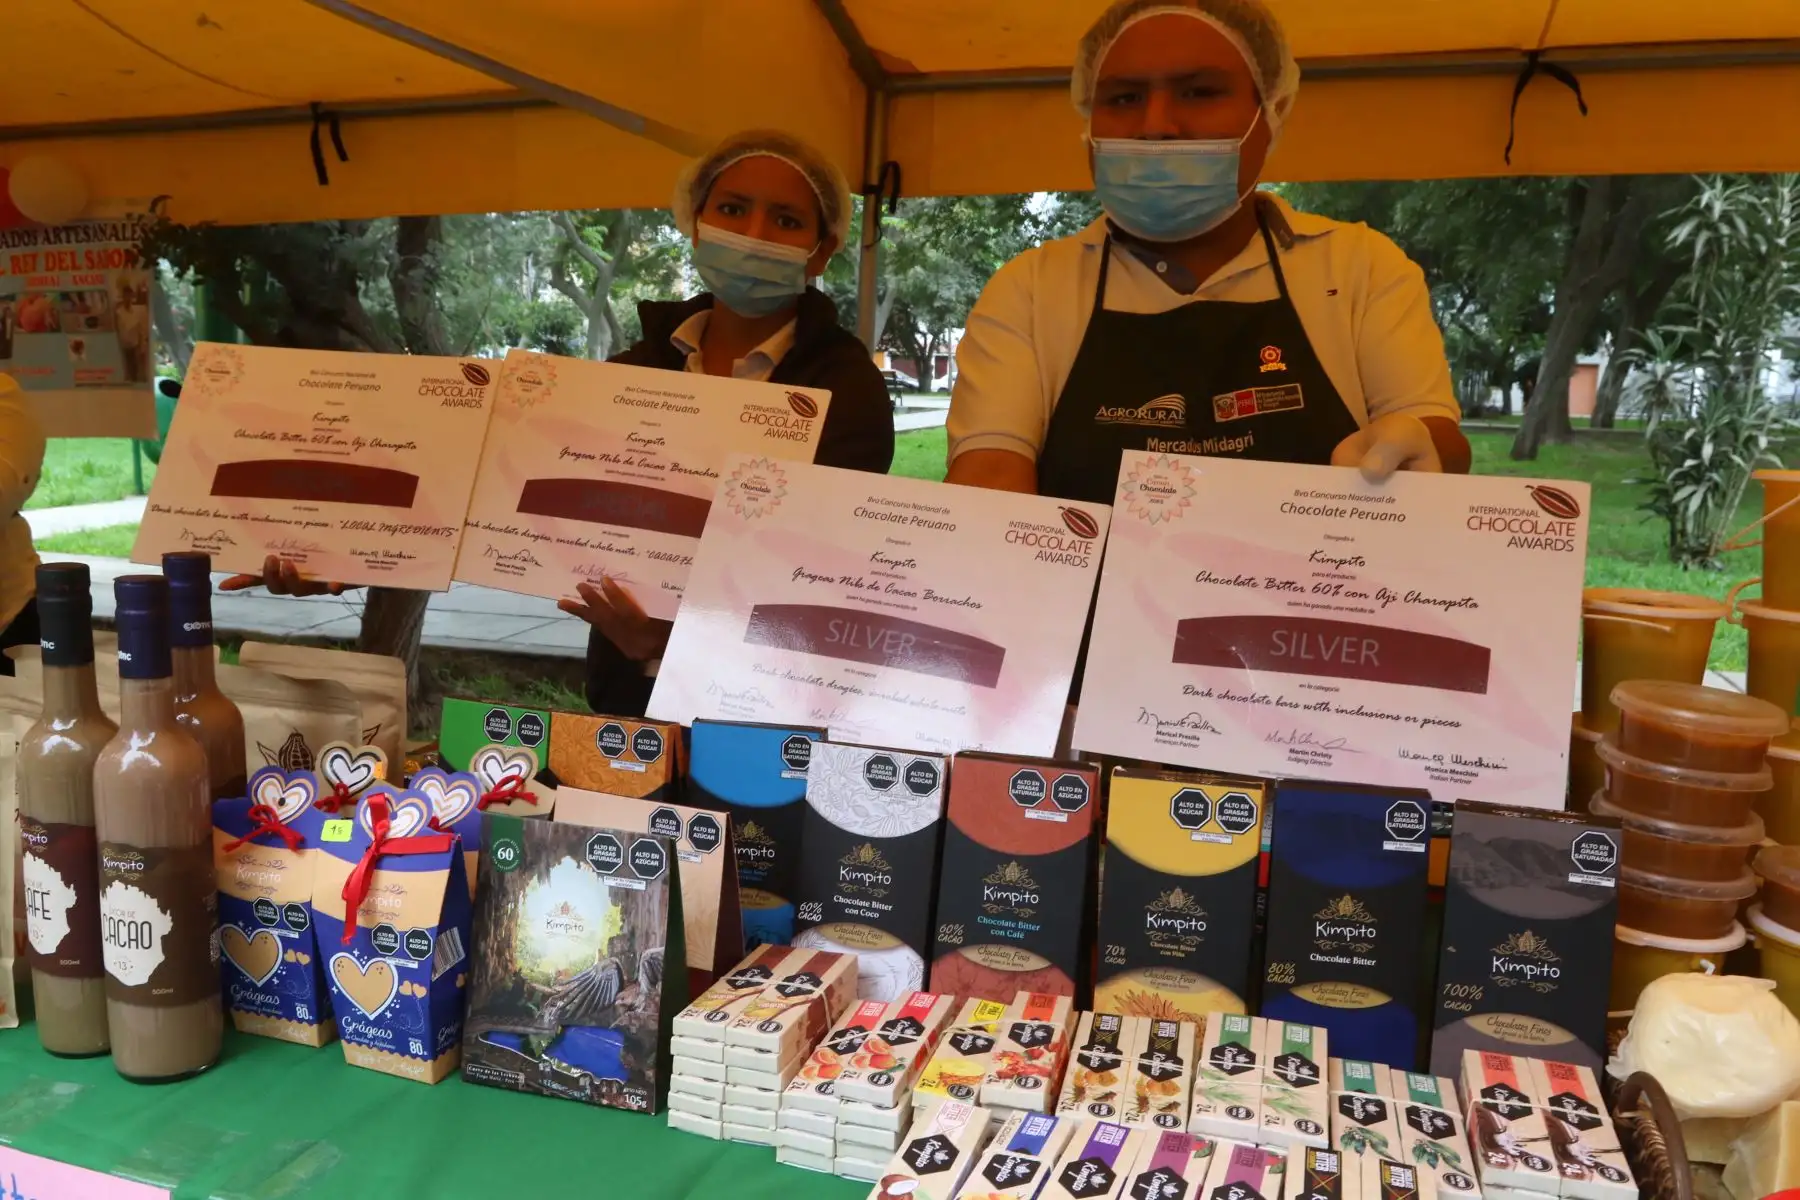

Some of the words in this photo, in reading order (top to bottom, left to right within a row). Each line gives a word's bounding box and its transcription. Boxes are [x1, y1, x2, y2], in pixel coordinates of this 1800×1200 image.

[44, 250, 83, 271] DEL
[299, 378, 343, 390] Chocolate
[344, 382, 381, 392] Peruano
[418, 385, 485, 399] CHOCOLATE
[441, 398, 482, 409] AWARDS
[613, 394, 660, 410] Chocolate
[661, 401, 700, 416] Peruano
[743, 403, 791, 417] INTERNATIONAL
[1096, 405, 1186, 421] AGRORURAL
[740, 411, 813, 433] CHOCOLATE
[625, 431, 666, 448] Kimpito
[764, 427, 809, 443] AWARDS
[1147, 437, 1201, 454] Mercados
[1202, 430, 1254, 454] Midagri
[1139, 483, 1177, 495] Chocolate
[1310, 490, 1347, 502] Concurso
[1348, 493, 1385, 504] Nacional
[1385, 496, 1396, 505] de
[912, 502, 941, 514] Nacional
[1280, 502, 1347, 519] Chocolate
[1349, 507, 1406, 524] Peruano
[1468, 505, 1540, 518] INTERNATIONAL
[853, 506, 909, 526] Chocolate
[909, 514, 957, 533] Peruano
[1467, 515, 1576, 537] CHOCOLATE
[1008, 520, 1067, 537] INTERNATIONAL
[1004, 529, 1094, 556] CHOCOLATE
[1507, 535, 1574, 553] AWARDS
[869, 550, 917, 570] Kimpito
[1034, 550, 1089, 570] AWARDS
[1308, 549, 1366, 570] Kimpito
[866, 580, 881, 592] de
[884, 582, 917, 598] Cacao
[922, 589, 984, 610] Borrachos
[1195, 570, 1260, 589] Chocolate
[1264, 576, 1306, 594] Bitter
[1311, 582, 1344, 598] 60%
[1344, 589, 1370, 600] con
[1403, 590, 1480, 613] Charapita
[825, 618, 917, 656] SILVER
[1270, 630, 1380, 667] SILVER
[1182, 684, 1214, 699] Dark
[1217, 690, 1272, 707] chocolate
[1274, 695, 1300, 711] bars
[1302, 700, 1332, 714] with
[1334, 704, 1402, 722] inclusions
[1403, 714, 1419, 723] or
[1419, 712, 1462, 730] pieces
[1178, 808, 1203, 816] AZÚCAR
[1218, 815, 1254, 823] SATURADAS
[1223, 809, 1249, 817] GRASAS
[1387, 822, 1423, 830] SATURADAS
[496, 846, 514, 862] 60
[593, 844, 608, 852] ALTO
[593, 850, 617, 858] GRASAS
[635, 851, 650, 859] ALTO
[1580, 848, 1608, 857] GRASAS
[103, 856, 144, 872] Kimpito
[588, 854, 622, 864] SATURADAS
[634, 858, 659, 867] AZÚCAR
[1574, 853, 1614, 864] SATURADAS
[839, 865, 892, 887] Kimpito
[833, 894, 870, 908] Chocolate
[871, 901, 893, 912] Bitter
[983, 885, 1040, 907] Kimpito
[797, 910, 823, 922] CACAO
[799, 902, 824, 914] 60%
[844, 907, 859, 916] con
[859, 908, 880, 920] Coco
[546, 918, 585, 934] Kimpito
[939, 922, 965, 937] 60%
[977, 915, 1017, 928] Chocolate
[1017, 920, 1042, 932] Bitter
[1146, 911, 1207, 934] Kimpito
[102, 912, 152, 950] CACAO
[937, 933, 964, 945] CACAO
[990, 928, 1006, 937] con
[1006, 928, 1026, 940] Café
[1315, 920, 1377, 943] Kimpito
[1104, 944, 1127, 957] 70%
[1103, 955, 1127, 966] CACAO
[1310, 952, 1352, 965] Chocolate
[1352, 956, 1377, 967] Bitter
[1268, 962, 1296, 976] 80%
[1492, 956, 1560, 980] Kimpito
[1266, 973, 1296, 985] CACAO
[230, 983, 280, 1006] Grágeas
[1443, 983, 1485, 1001] 100%
[295, 1005, 309, 1021] 80
[1443, 1000, 1473, 1012] CACAO
[342, 1016, 393, 1040] Grágeas
[409, 1040, 424, 1055] 80
[623, 1093, 648, 1109] 105g
